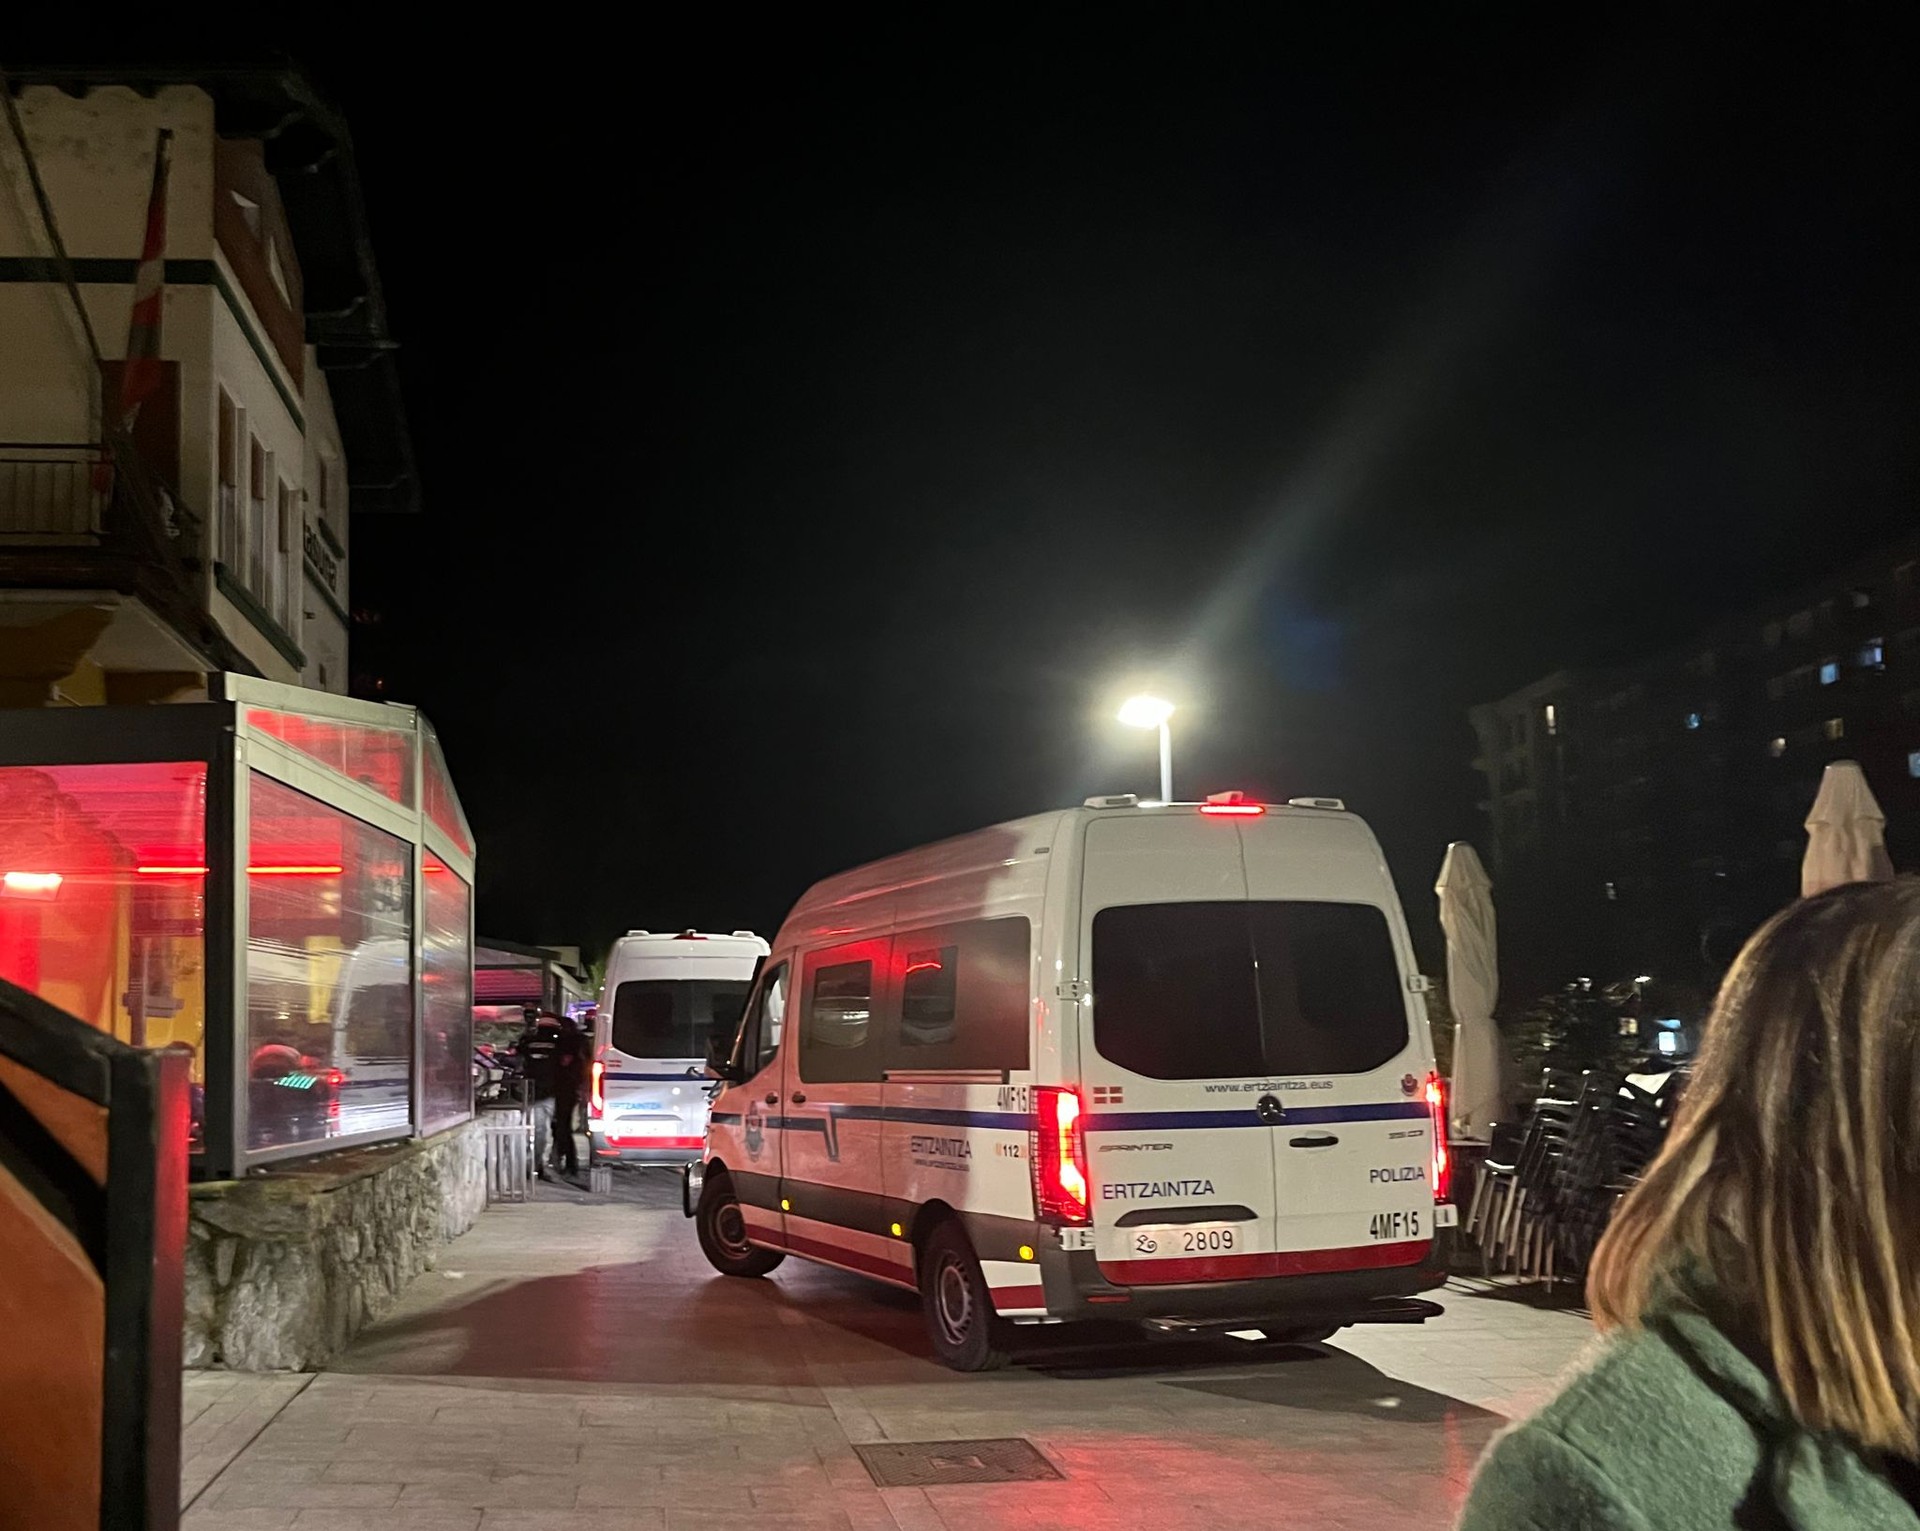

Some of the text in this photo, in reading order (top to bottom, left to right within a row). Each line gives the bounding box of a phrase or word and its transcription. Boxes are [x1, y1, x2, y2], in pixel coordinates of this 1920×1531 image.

[1205, 1080, 1333, 1093] www.ertzaintza.eus
[997, 1087, 1027, 1112] 4MF15
[911, 1136, 972, 1159] ERTZAINTZA
[1003, 1144, 1019, 1158] 112
[1098, 1143, 1174, 1153] SPRINTER
[1369, 1166, 1425, 1184] POLIZIA
[1103, 1180, 1216, 1200] ERTZAINTZA
[1369, 1211, 1420, 1240] 4MF15
[1183, 1230, 1234, 1252] 2809
